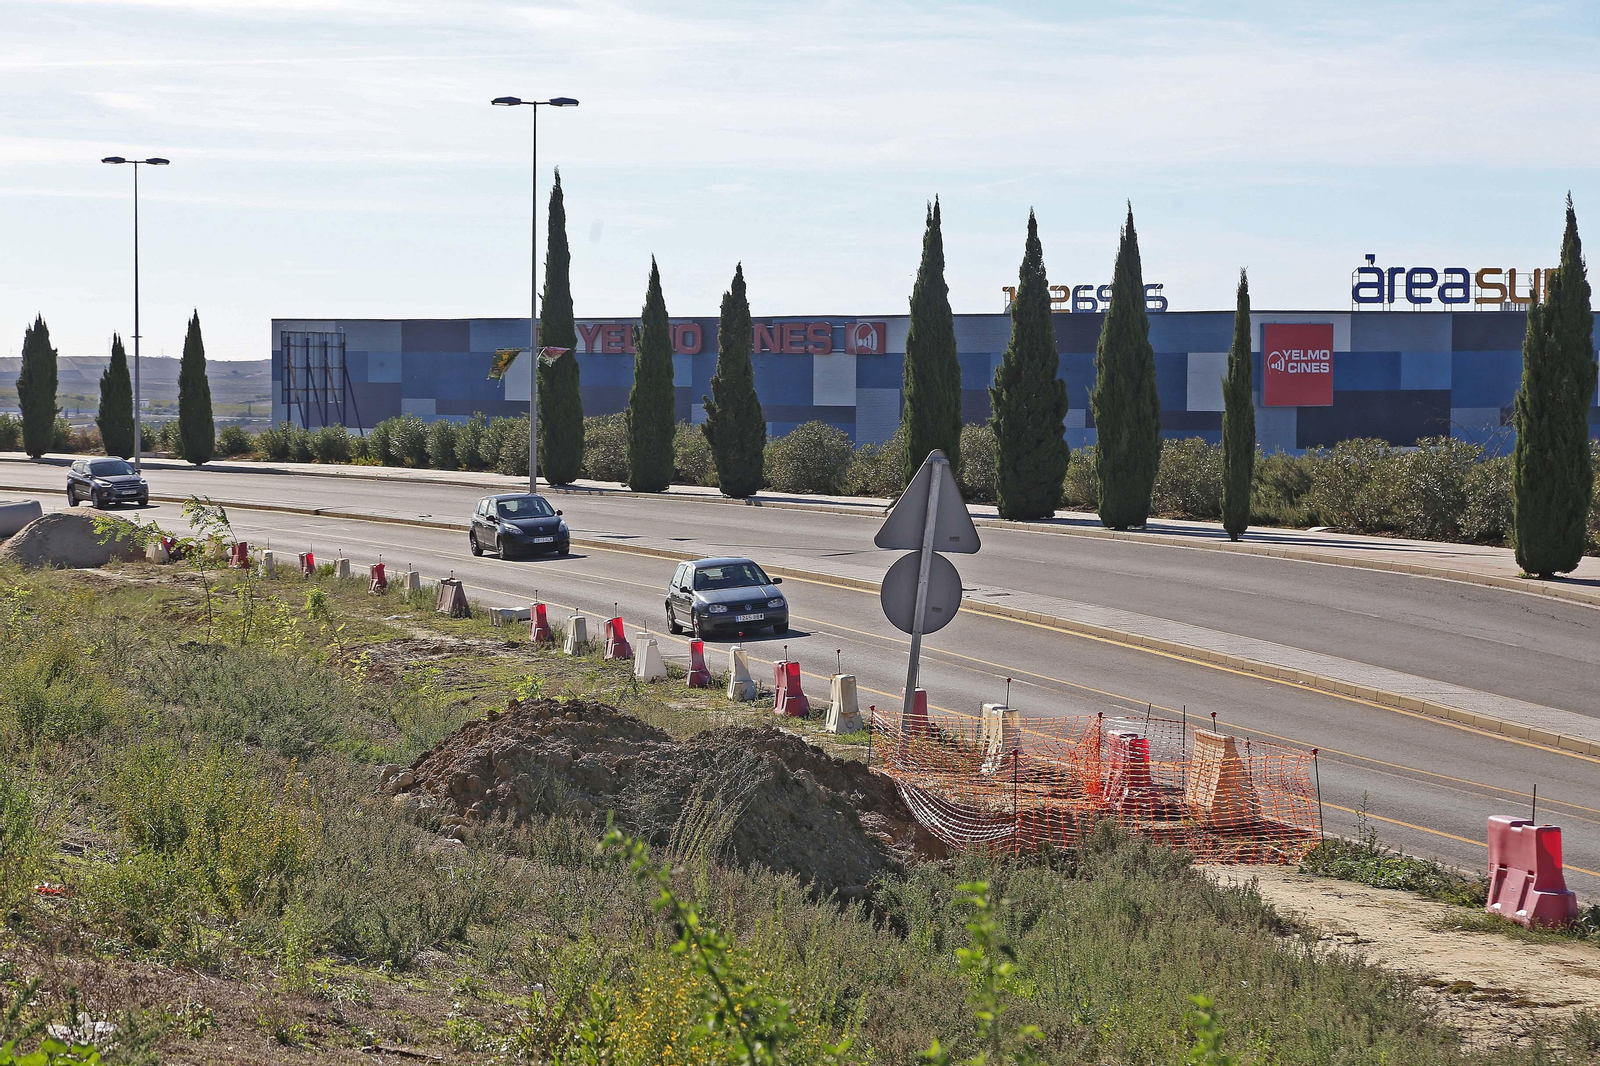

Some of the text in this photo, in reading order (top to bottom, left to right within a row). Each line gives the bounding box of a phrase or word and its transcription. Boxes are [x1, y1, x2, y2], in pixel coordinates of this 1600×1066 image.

[576, 323, 703, 354] YELO
[1282, 349, 1330, 361] YELMO
[1287, 362, 1330, 374] CINES
